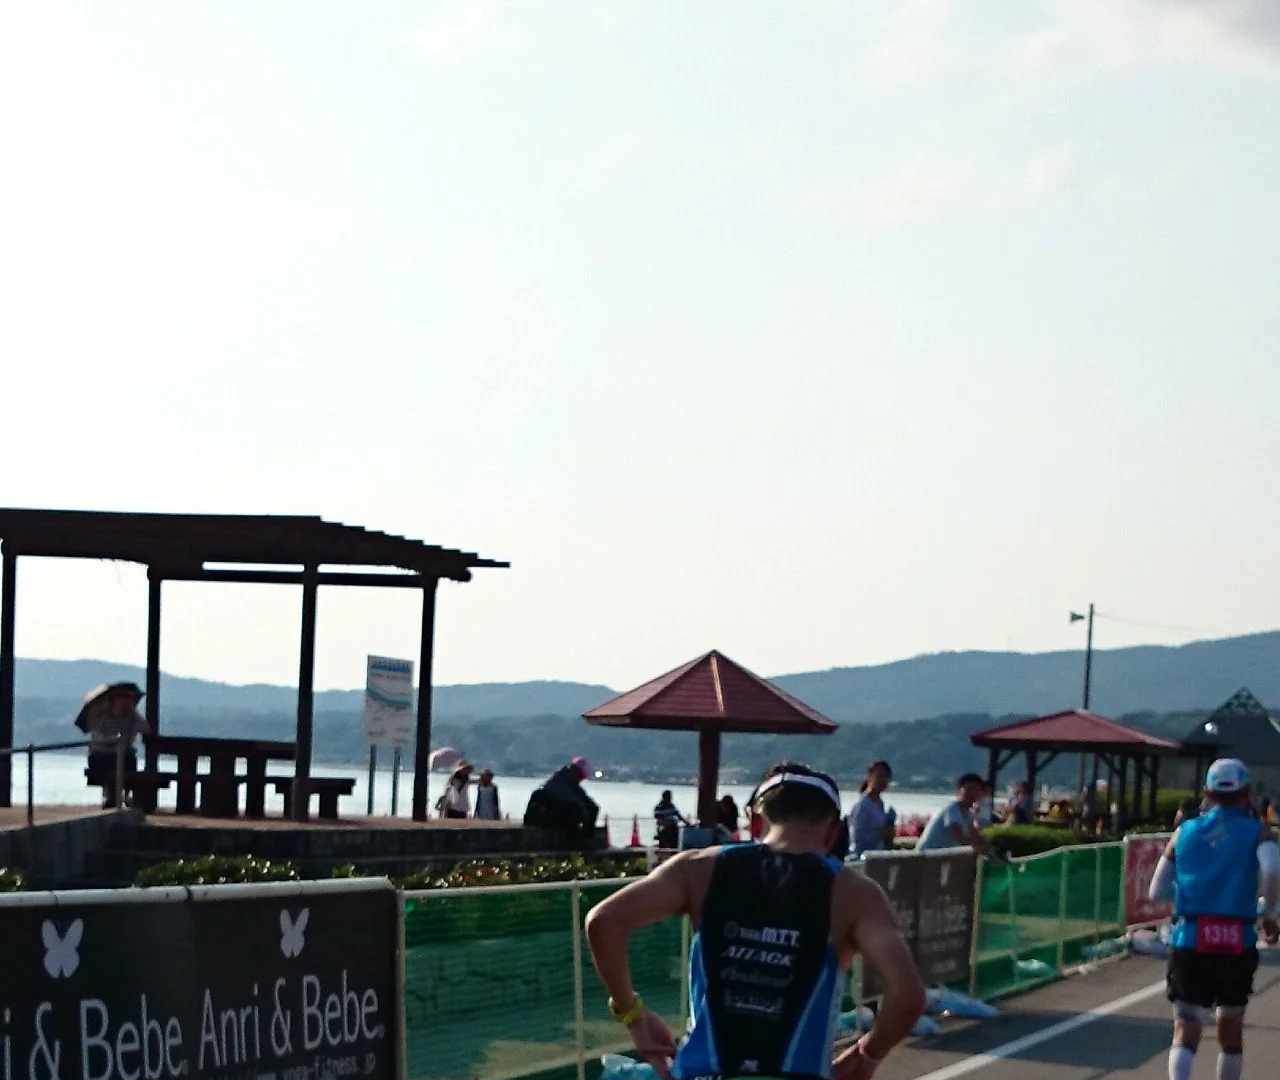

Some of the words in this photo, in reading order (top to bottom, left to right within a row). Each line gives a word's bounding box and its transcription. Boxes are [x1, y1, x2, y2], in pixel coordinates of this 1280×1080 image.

[198, 983, 261, 1070] Anri
[271, 977, 292, 1056] &
[303, 969, 379, 1050] Bebe
